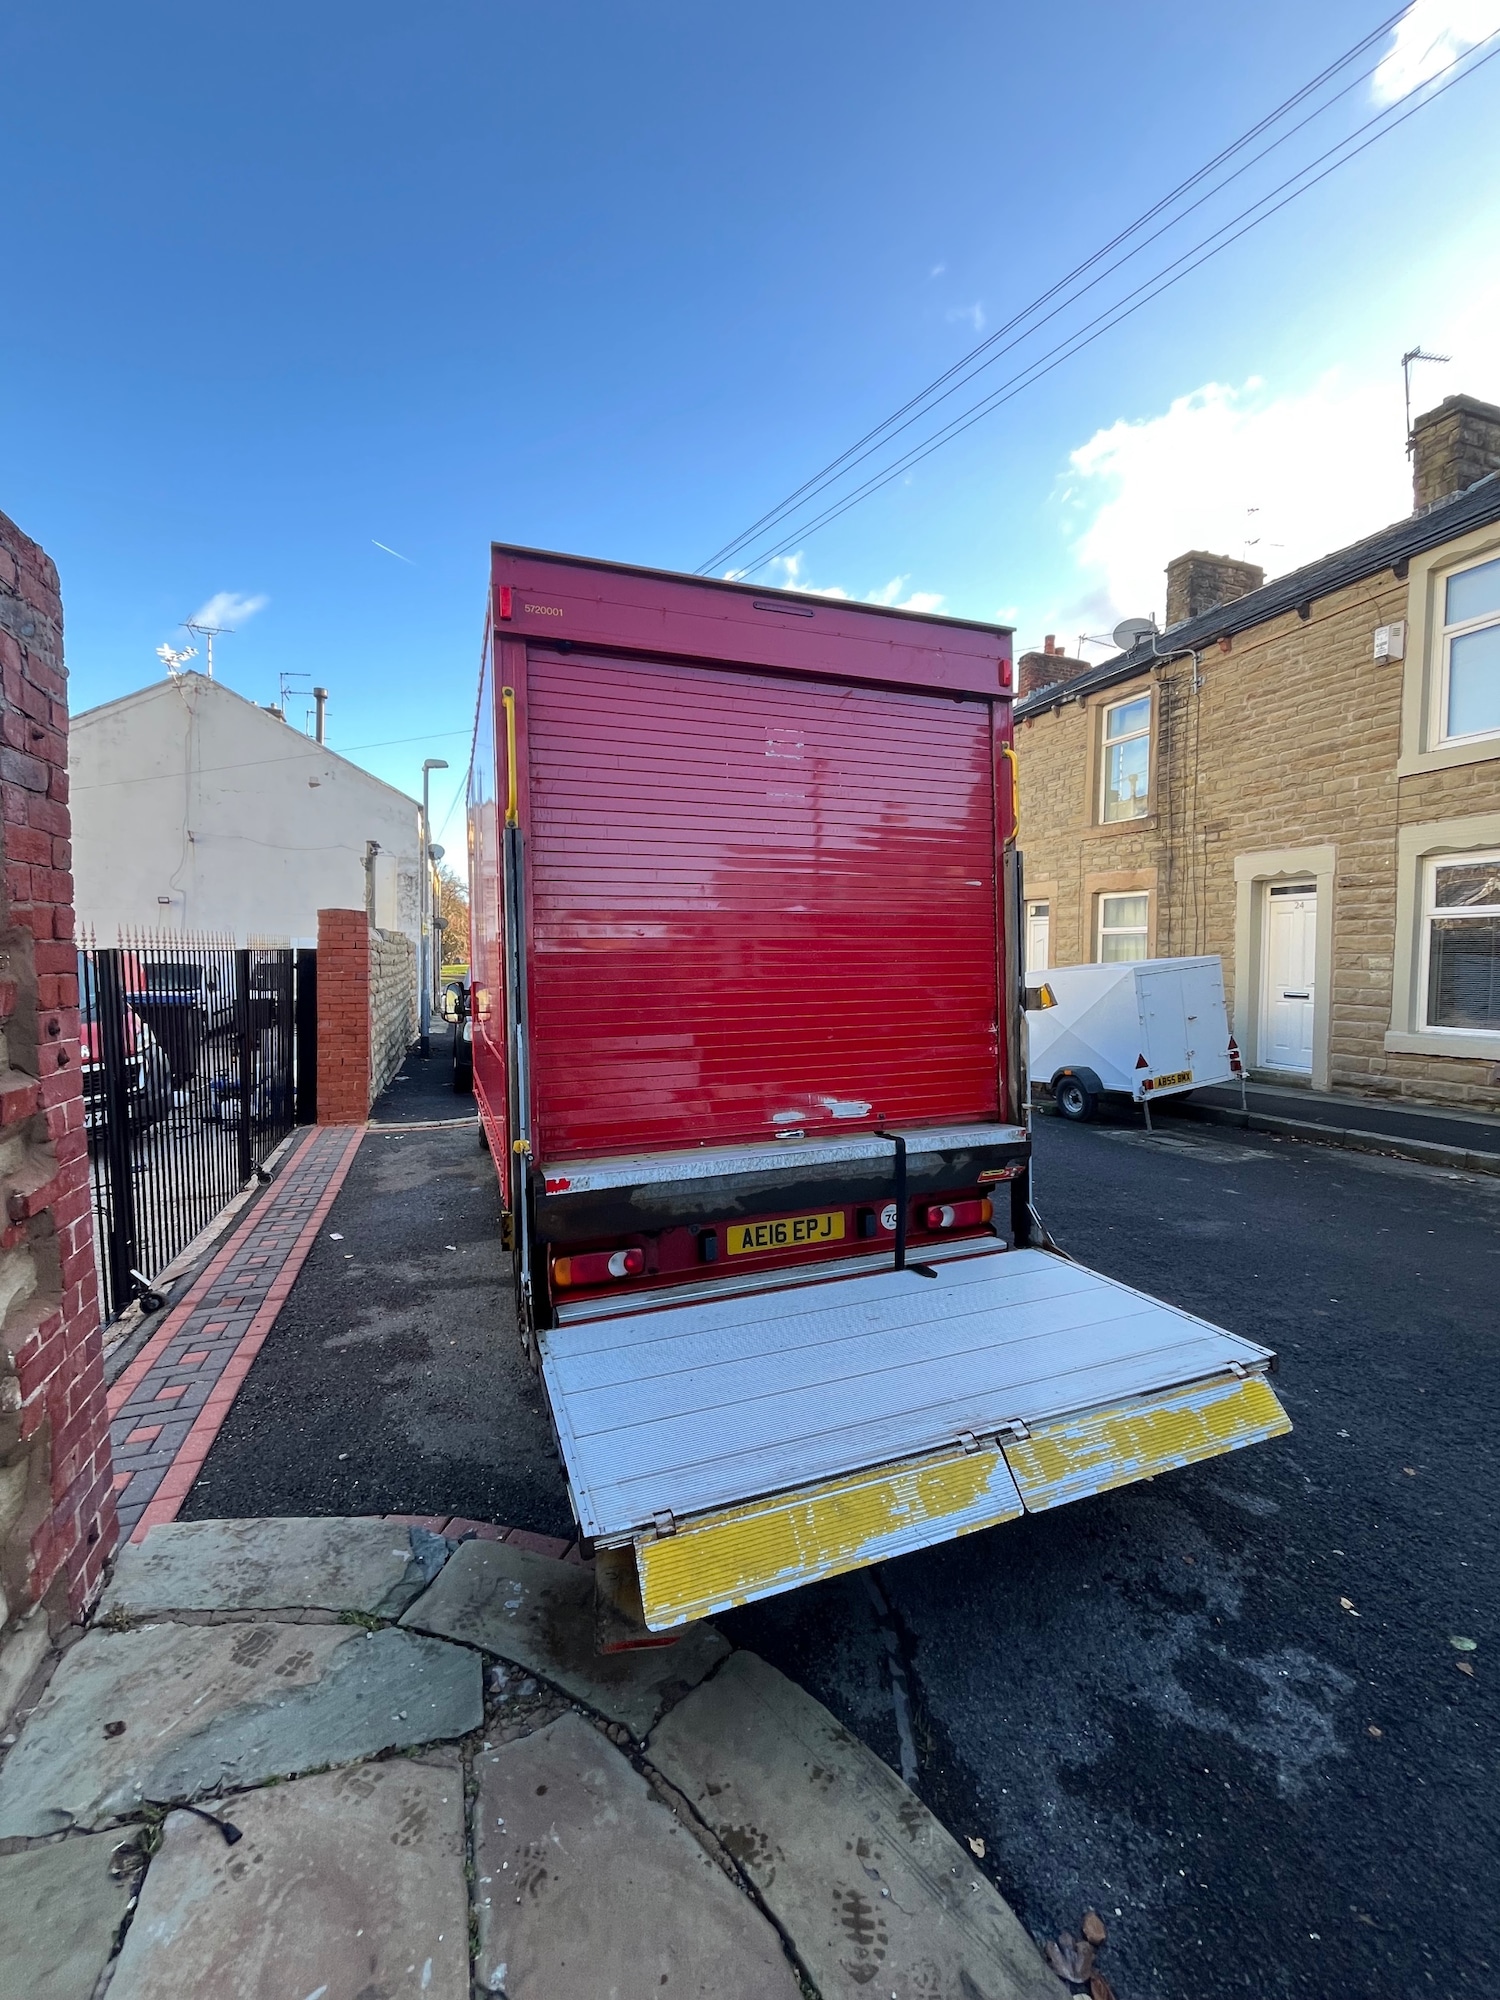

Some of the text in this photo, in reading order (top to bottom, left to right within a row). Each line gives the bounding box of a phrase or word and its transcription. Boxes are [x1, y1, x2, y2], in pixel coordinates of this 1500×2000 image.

[524, 604, 563, 617] 5720001
[1294, 901, 1305, 910] 24
[1158, 1072, 1191, 1087] AB55 BMX
[742, 1216, 832, 1249] AE16 EPJ
